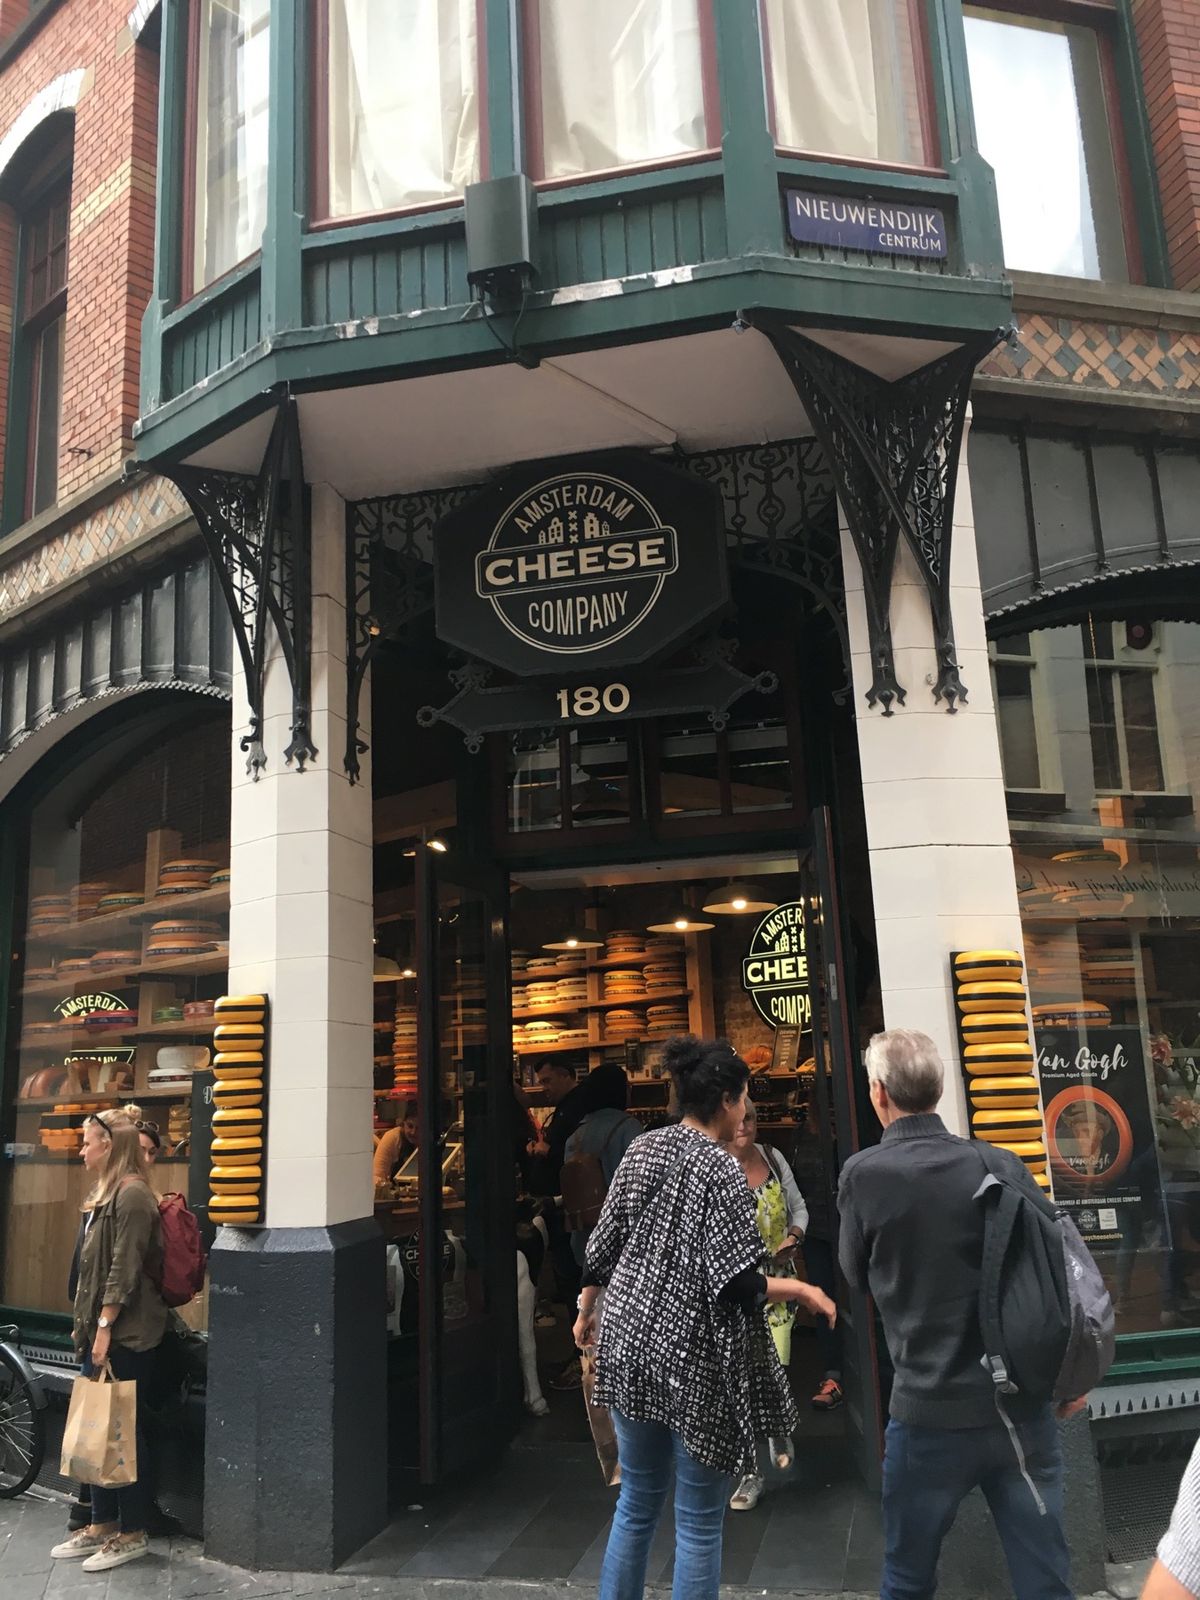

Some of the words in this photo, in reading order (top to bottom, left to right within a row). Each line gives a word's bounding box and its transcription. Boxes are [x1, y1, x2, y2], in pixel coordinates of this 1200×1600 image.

[795, 196, 939, 237] NIEUWENDIJK
[878, 232, 942, 251] CENTRUM
[513, 484, 635, 534] AMSTERDAM
[484, 537, 667, 586] CHEESE
[528, 590, 629, 636] COMPANY
[556, 683, 631, 718] 180
[1074, 1043, 1129, 1081] Gogh
